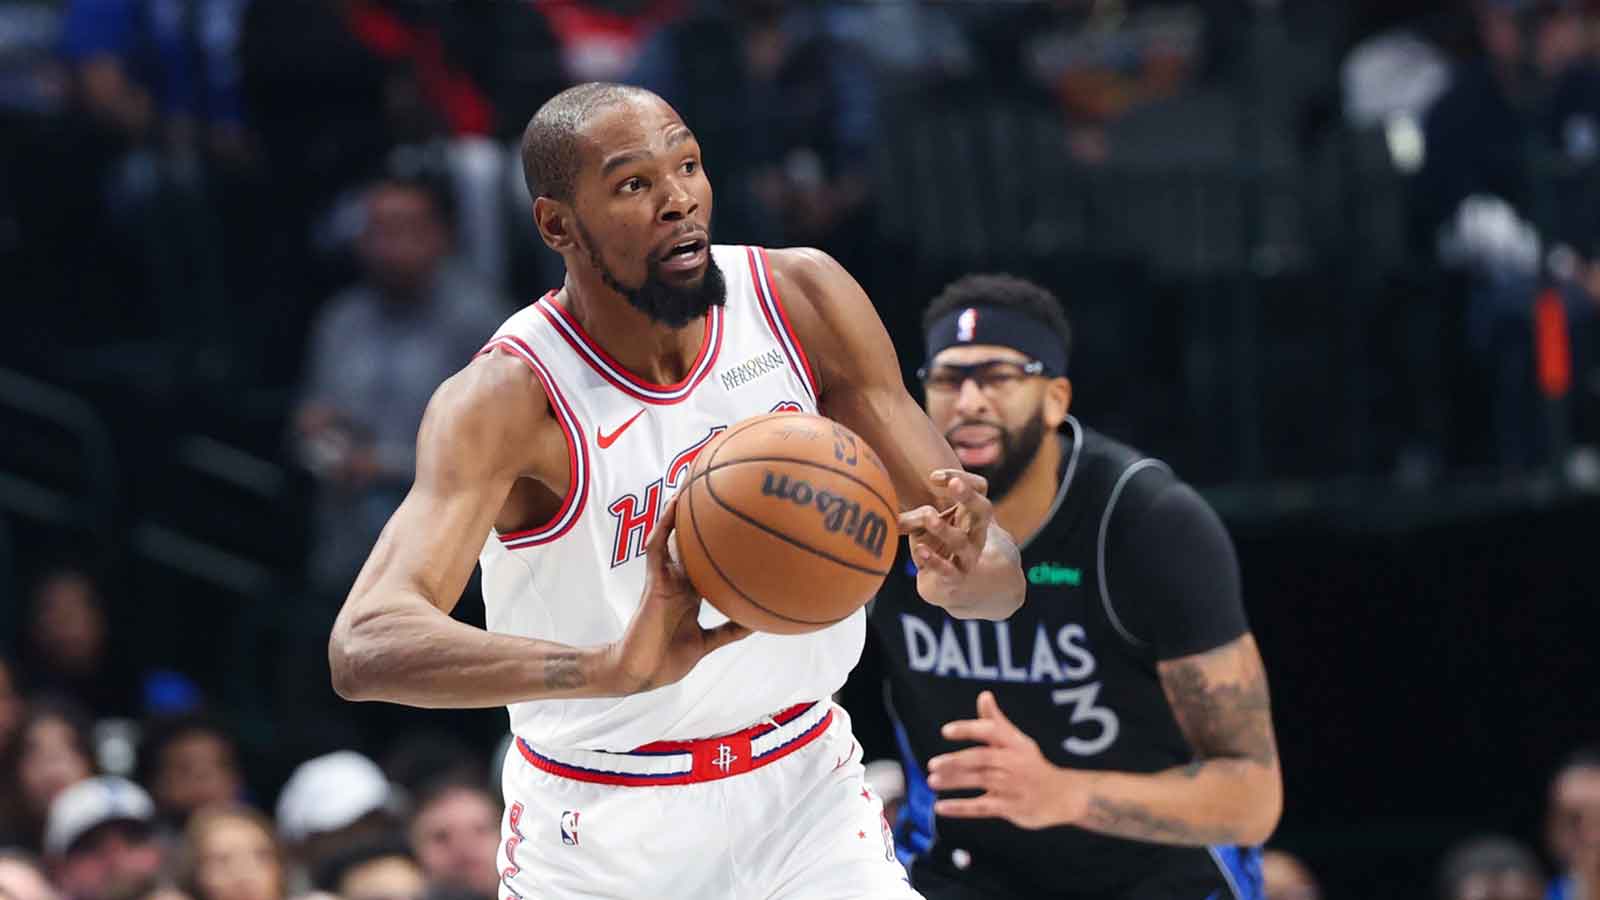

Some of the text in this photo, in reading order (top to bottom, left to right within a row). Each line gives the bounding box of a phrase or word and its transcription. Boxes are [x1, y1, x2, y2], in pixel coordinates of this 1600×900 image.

[720, 348, 784, 381] MEMORIAL
[722, 357, 785, 391] HERMANN
[763, 472, 888, 559] Wilson
[901, 613, 1095, 682] DALLAS
[1051, 682, 1120, 756] 3
